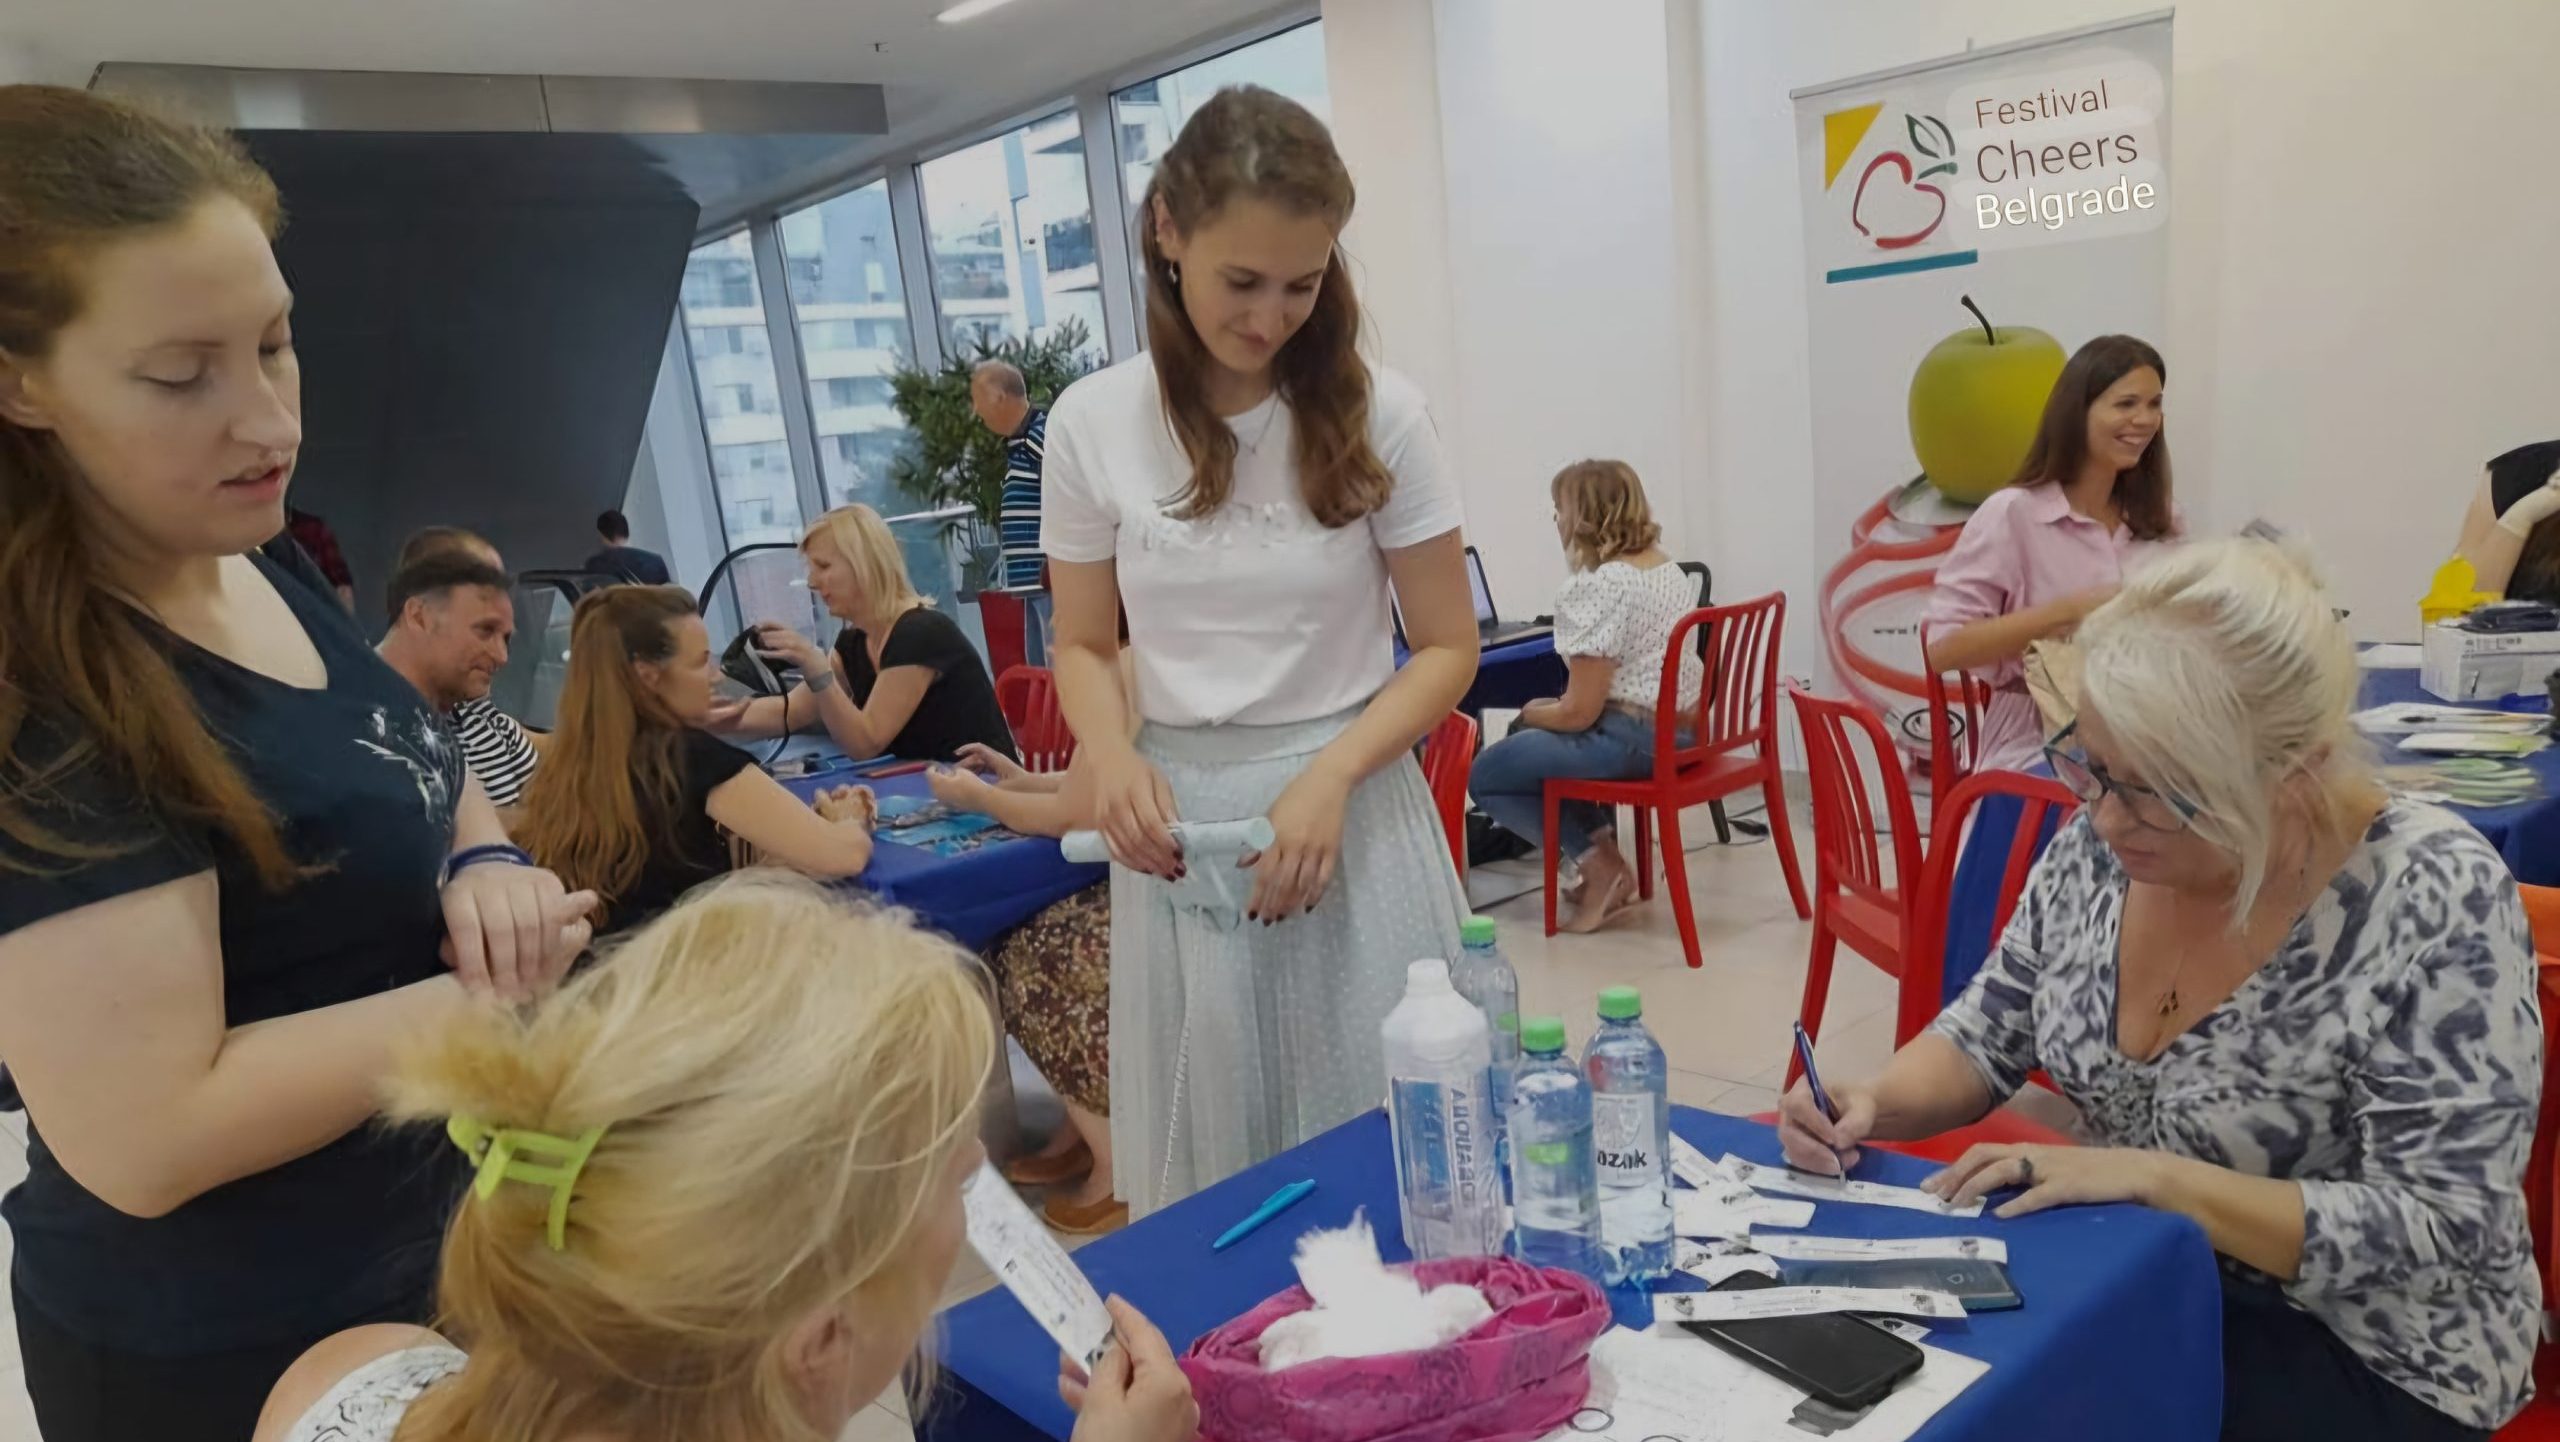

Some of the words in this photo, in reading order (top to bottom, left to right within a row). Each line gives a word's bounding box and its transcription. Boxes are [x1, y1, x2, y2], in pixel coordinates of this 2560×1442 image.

[1975, 78, 2109, 129] Festival
[1976, 133, 2138, 184] Cheers
[1975, 174, 2156, 230] Belgrade
